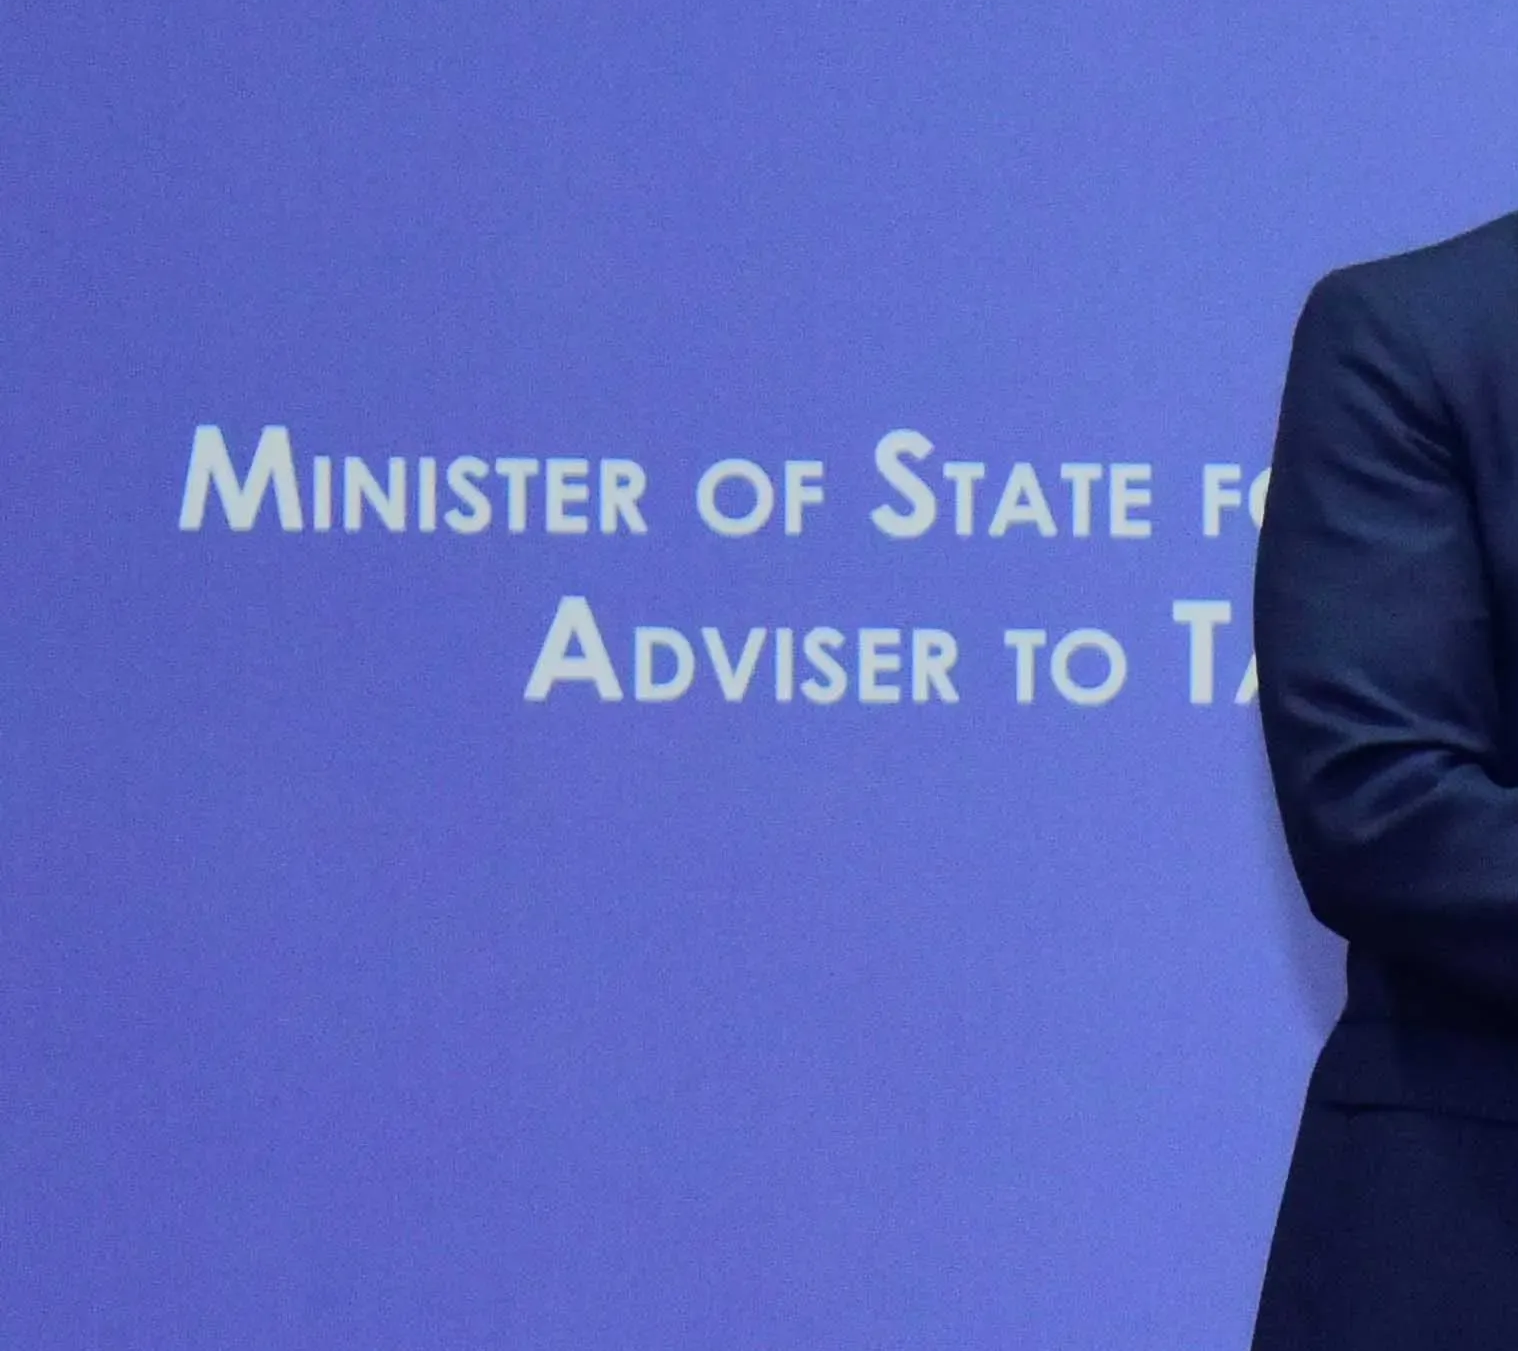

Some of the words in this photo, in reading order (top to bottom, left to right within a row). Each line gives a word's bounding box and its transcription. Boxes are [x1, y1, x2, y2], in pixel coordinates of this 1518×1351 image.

[179, 425, 647, 533] MINISTER
[696, 458, 824, 536] OF
[871, 429, 1152, 538] STATE
[524, 596, 959, 704] ADVISER
[1004, 628, 1127, 705] TO
